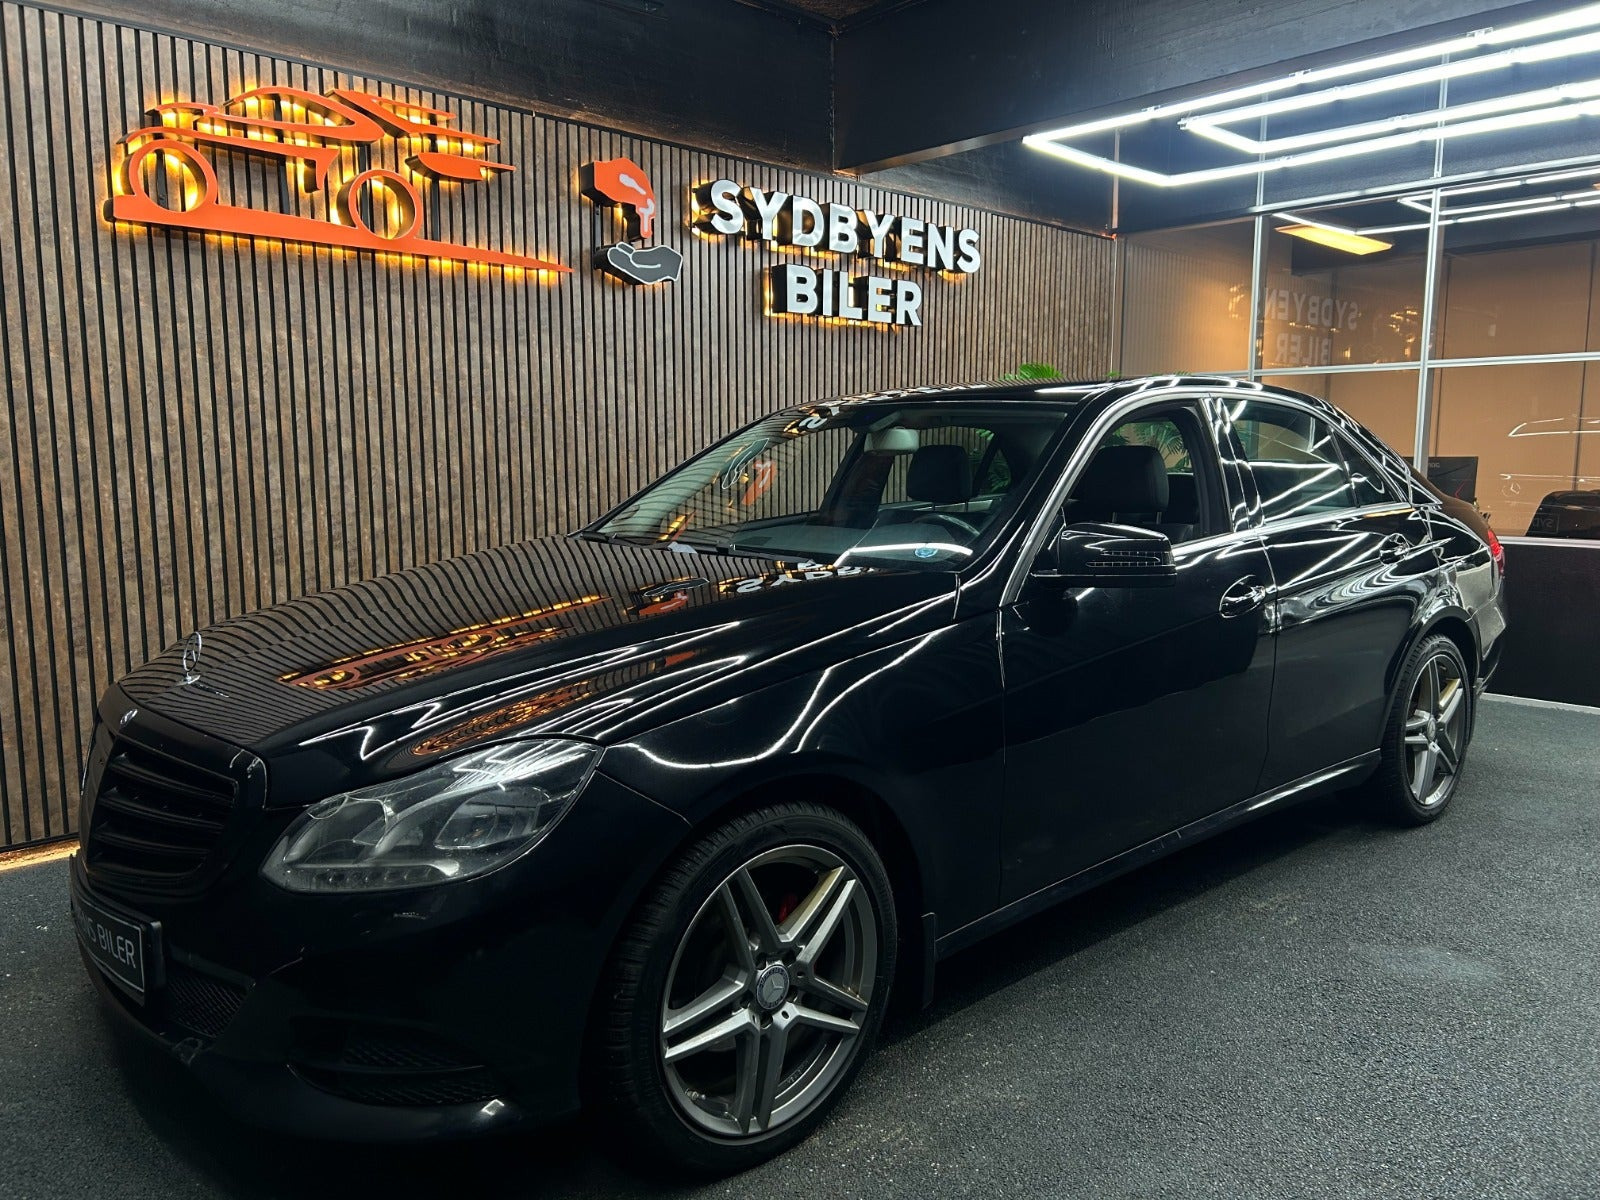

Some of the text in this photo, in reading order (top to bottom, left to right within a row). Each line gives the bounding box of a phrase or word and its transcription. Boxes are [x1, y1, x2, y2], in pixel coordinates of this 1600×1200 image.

[710, 179, 981, 274] SYDBYENS
[786, 263, 922, 327] BILER
[97, 924, 136, 969] BILER
